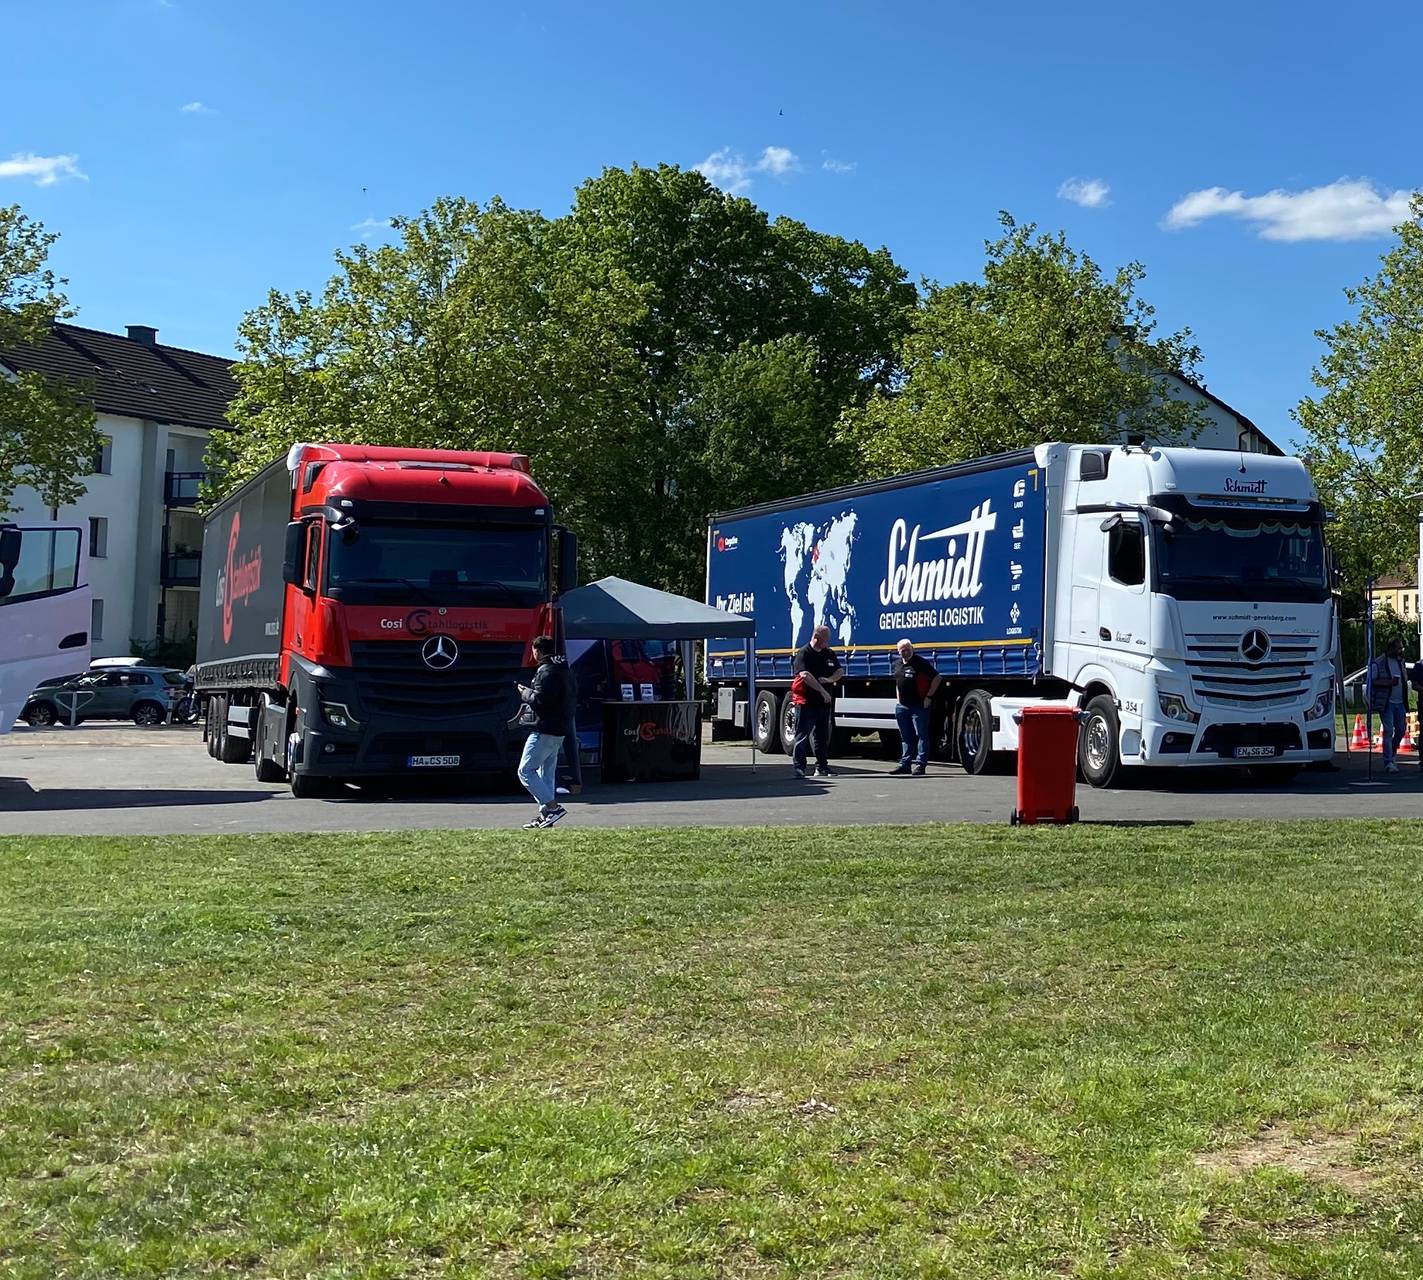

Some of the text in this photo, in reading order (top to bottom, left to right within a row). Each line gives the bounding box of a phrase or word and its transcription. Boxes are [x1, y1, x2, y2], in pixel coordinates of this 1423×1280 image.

[1223, 477, 1268, 493] Schmidt
[879, 498, 997, 606] Schmidt
[716, 592, 754, 614] Ihr Ziel ist
[380, 618, 403, 629] Cosi
[880, 606, 984, 630] GEVELSBERG LOGISTIK
[1125, 701, 1138, 712] 354
[412, 757, 424, 765] HA
[430, 757, 441, 765] CS
